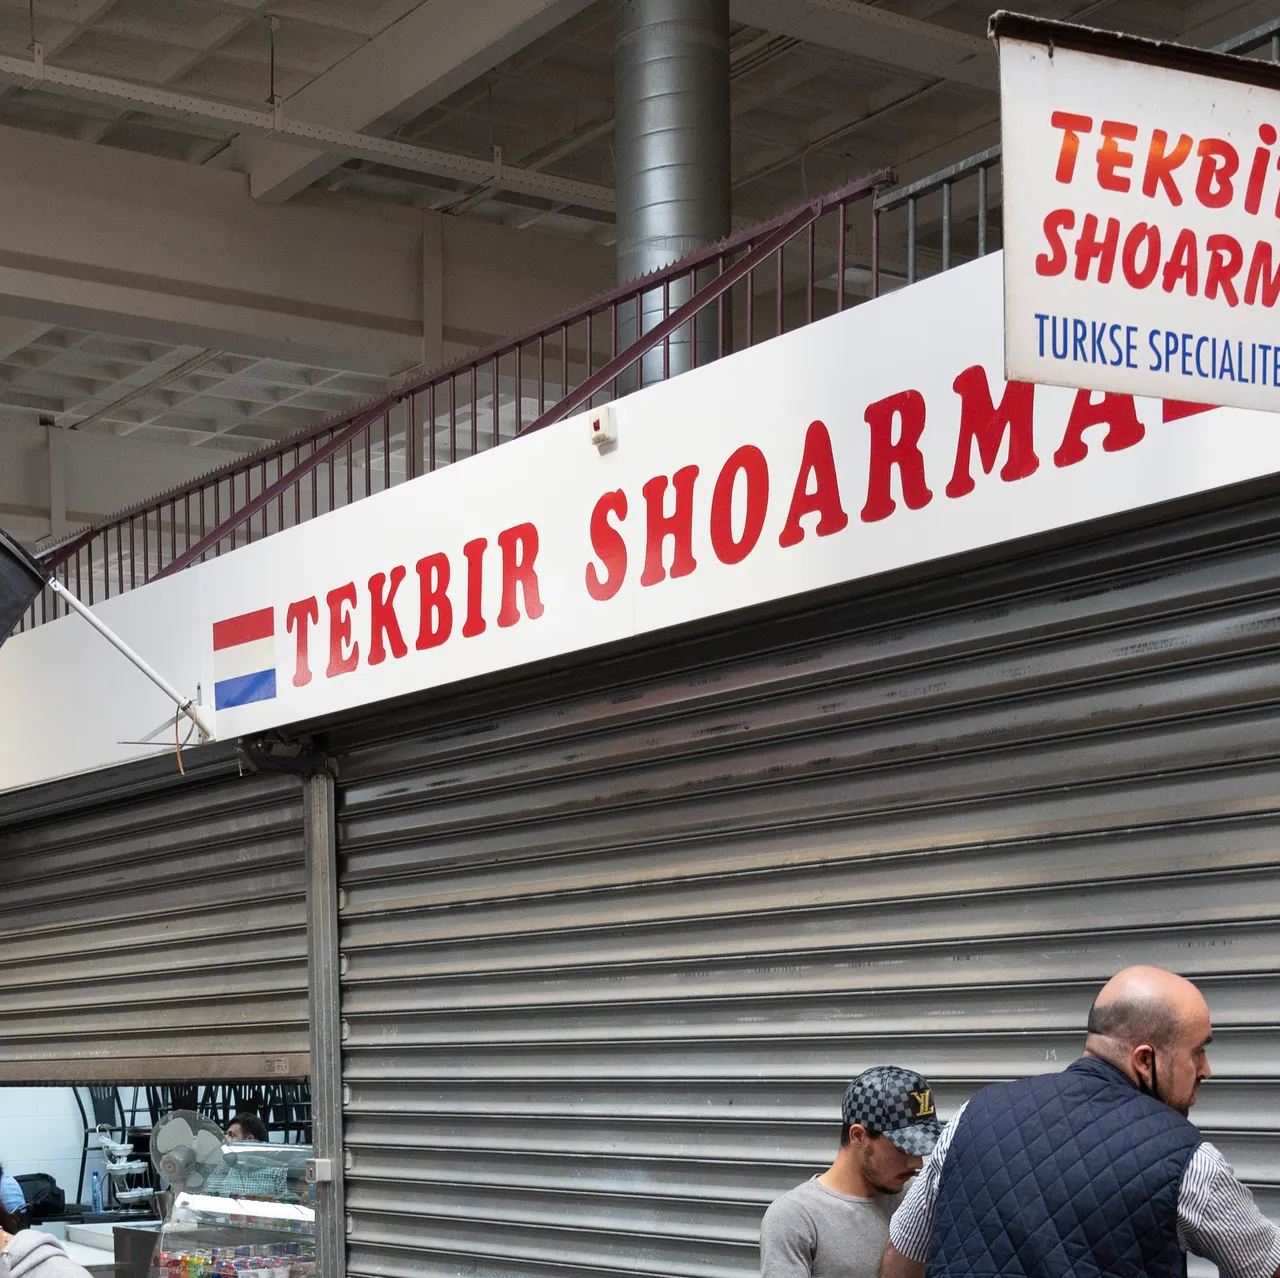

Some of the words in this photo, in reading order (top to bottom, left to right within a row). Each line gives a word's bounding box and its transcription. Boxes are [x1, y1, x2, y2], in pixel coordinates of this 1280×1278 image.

[1034, 314, 1139, 370] TURKSE
[287, 520, 546, 688] TEKBIR
[585, 364, 1147, 603] SHOARMA
